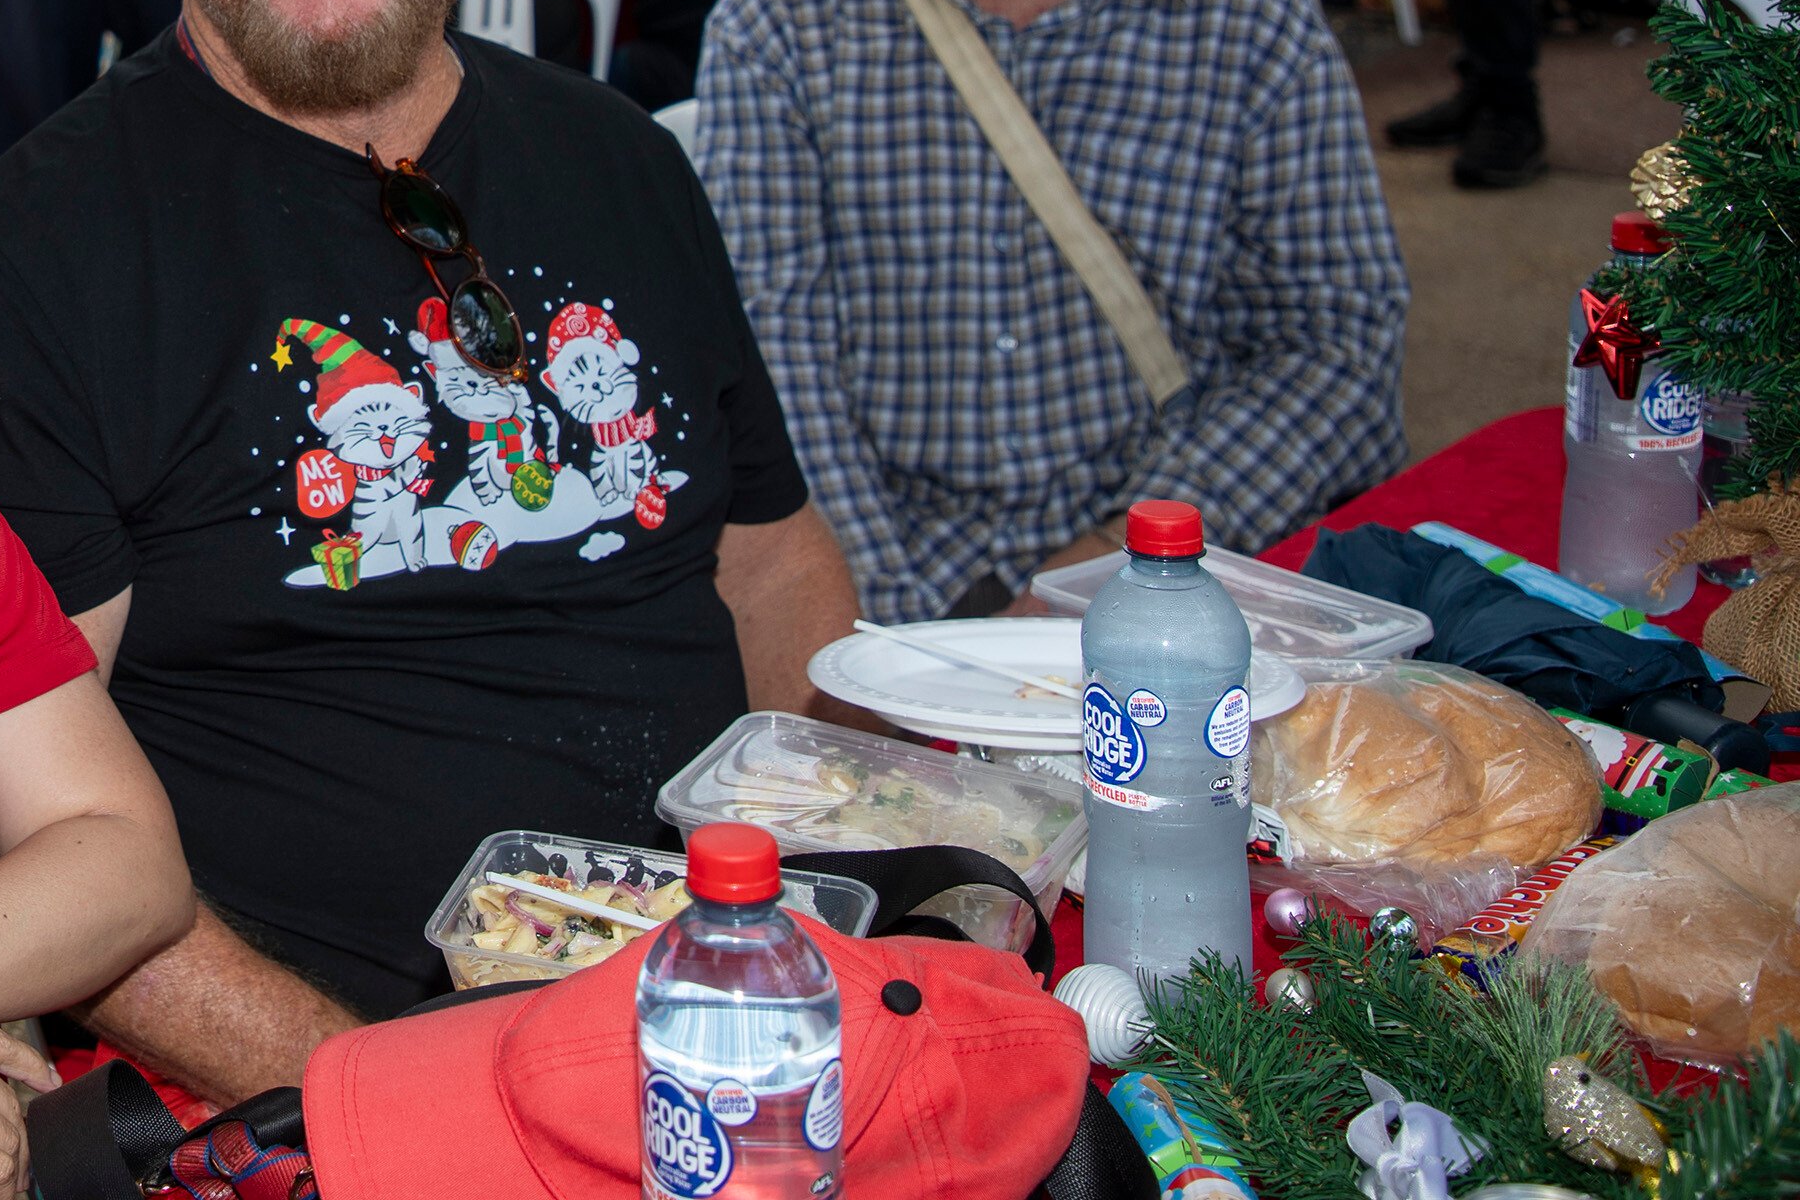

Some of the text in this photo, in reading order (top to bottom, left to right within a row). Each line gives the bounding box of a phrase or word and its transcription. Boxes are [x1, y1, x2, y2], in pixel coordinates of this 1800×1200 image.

[300, 453, 342, 487] ME
[309, 478, 345, 508] OW
[1084, 700, 1129, 743] COOL
[1130, 703, 1160, 711] CARBON
[1130, 710, 1163, 718] NEUTRAL
[1082, 720, 1133, 769] RIDGE
[1089, 779, 1127, 803] RECYCLED
[1213, 777, 1233, 789] AFL
[646, 1089, 712, 1145] COOL
[645, 1112, 718, 1180] RIDGE
